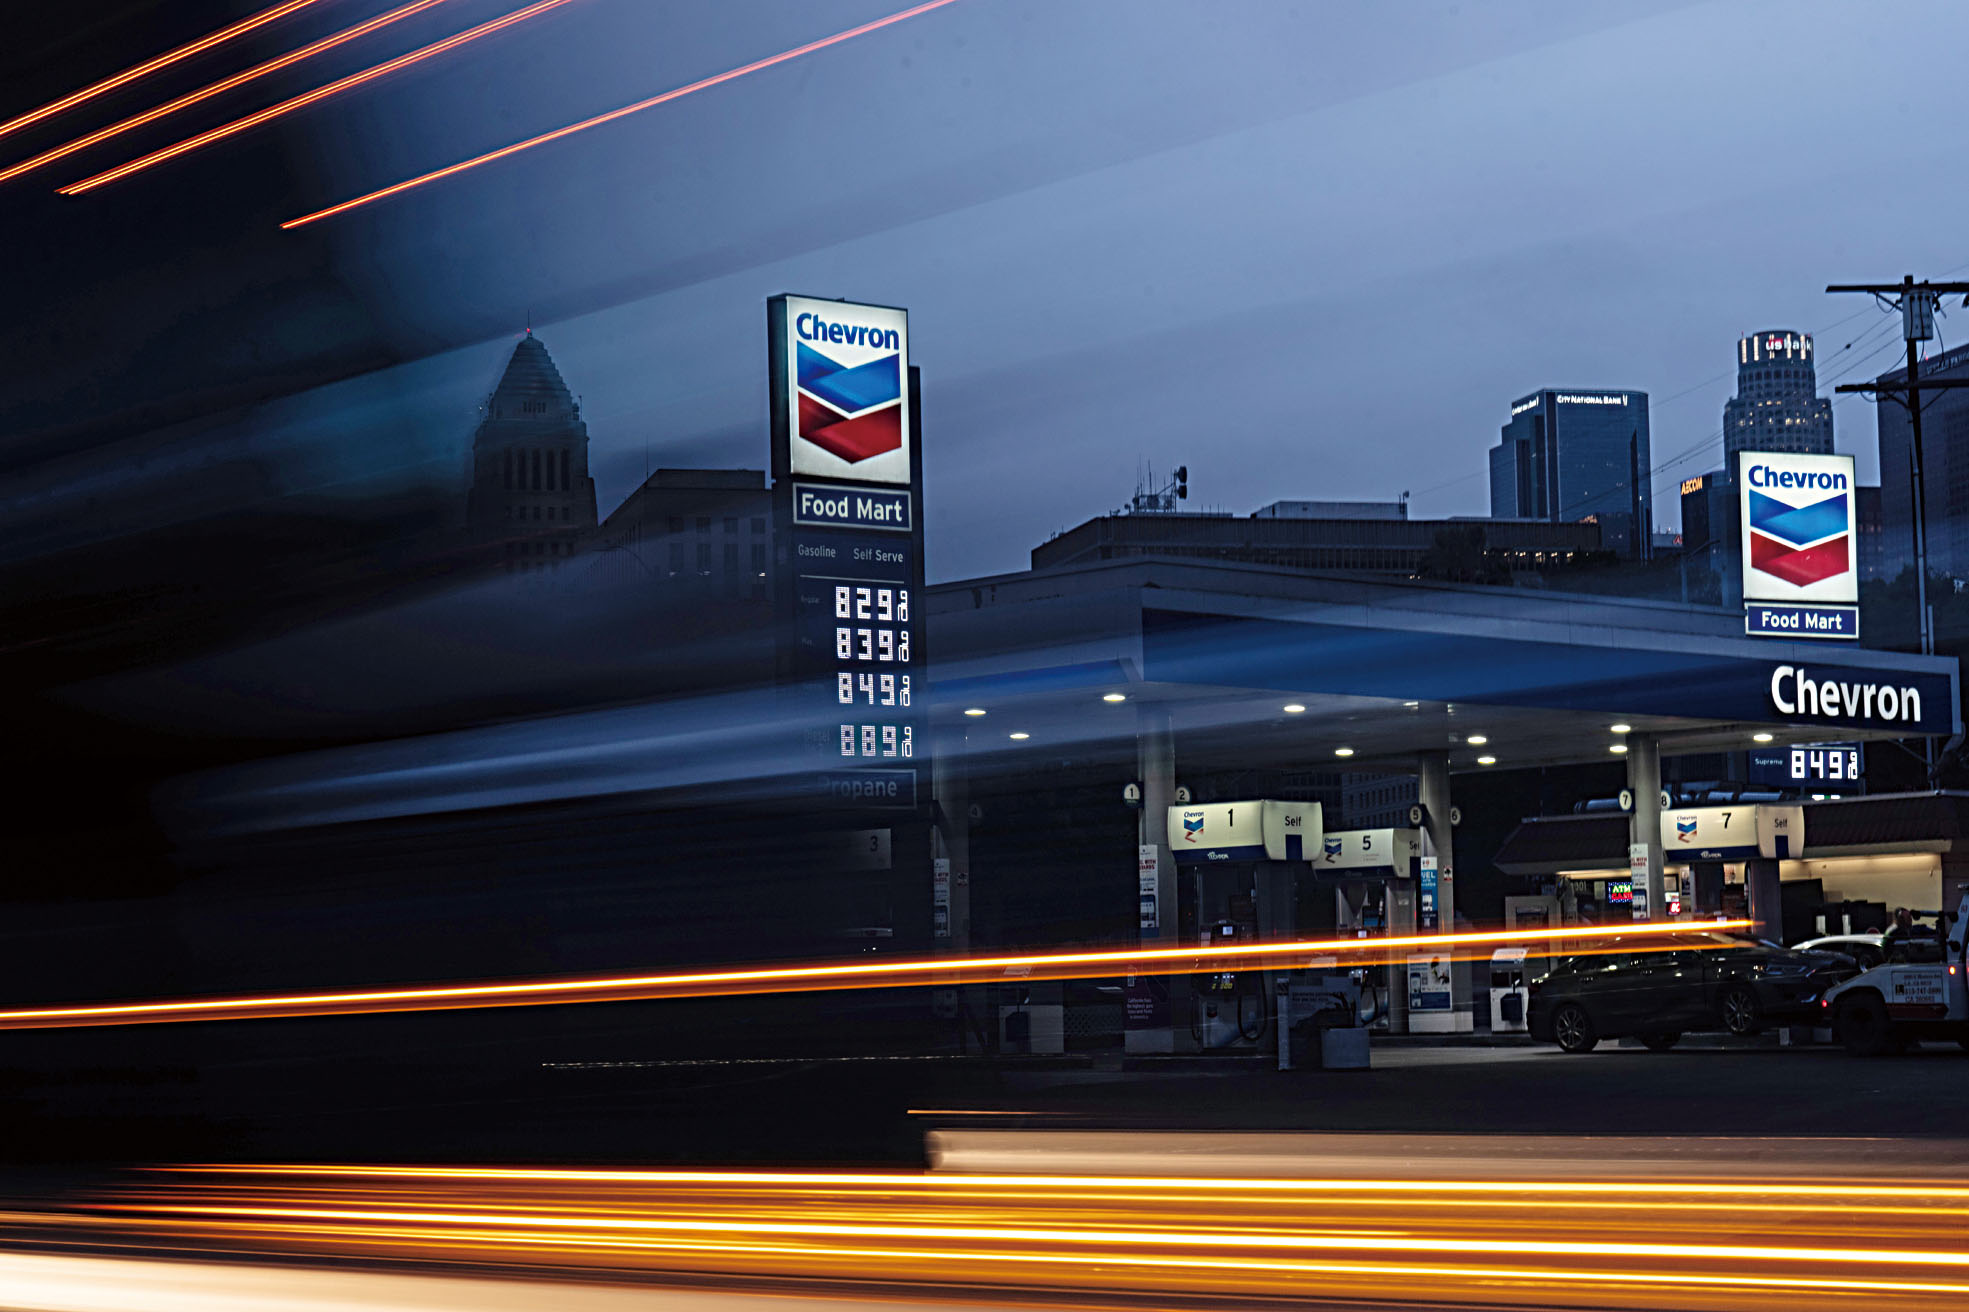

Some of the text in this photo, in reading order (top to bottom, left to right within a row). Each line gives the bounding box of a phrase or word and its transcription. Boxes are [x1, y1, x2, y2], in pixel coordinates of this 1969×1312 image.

[797, 312, 899, 350] Chevron
[1749, 465, 1847, 490] Chevron
[1681, 477, 1703, 496] AECOM
[802, 493, 902, 522] Food Mart
[798, 544, 904, 562] Gasoline Self Serve
[836, 587, 892, 621] 829
[1762, 611, 1842, 630] Food Mart
[837, 628, 894, 661] 839
[838, 672, 895, 706] 849
[1771, 665, 1921, 722] Chevron
[841, 725, 897, 757] 889
[1755, 758, 1783, 766] Supreme
[1791, 750, 1843, 779] 849
[1130, 787, 1134, 798] 1
[1179, 790, 1185, 800] 2
[1623, 795, 1629, 805] 7
[1184, 811, 1204, 820] Chevron
[1228, 808, 1233, 826] 1
[1285, 815, 1302, 827] Self
[1412, 809, 1419, 820] 5
[1452, 810, 1458, 820] 6
[1721, 812, 1731, 829] 7
[1774, 818, 1788, 828] Self
[870, 835, 878, 851] 3
[1362, 835, 1372, 850] 5
[1409, 840, 1419, 850] Sel
[1612, 885, 1631, 893] ATM
